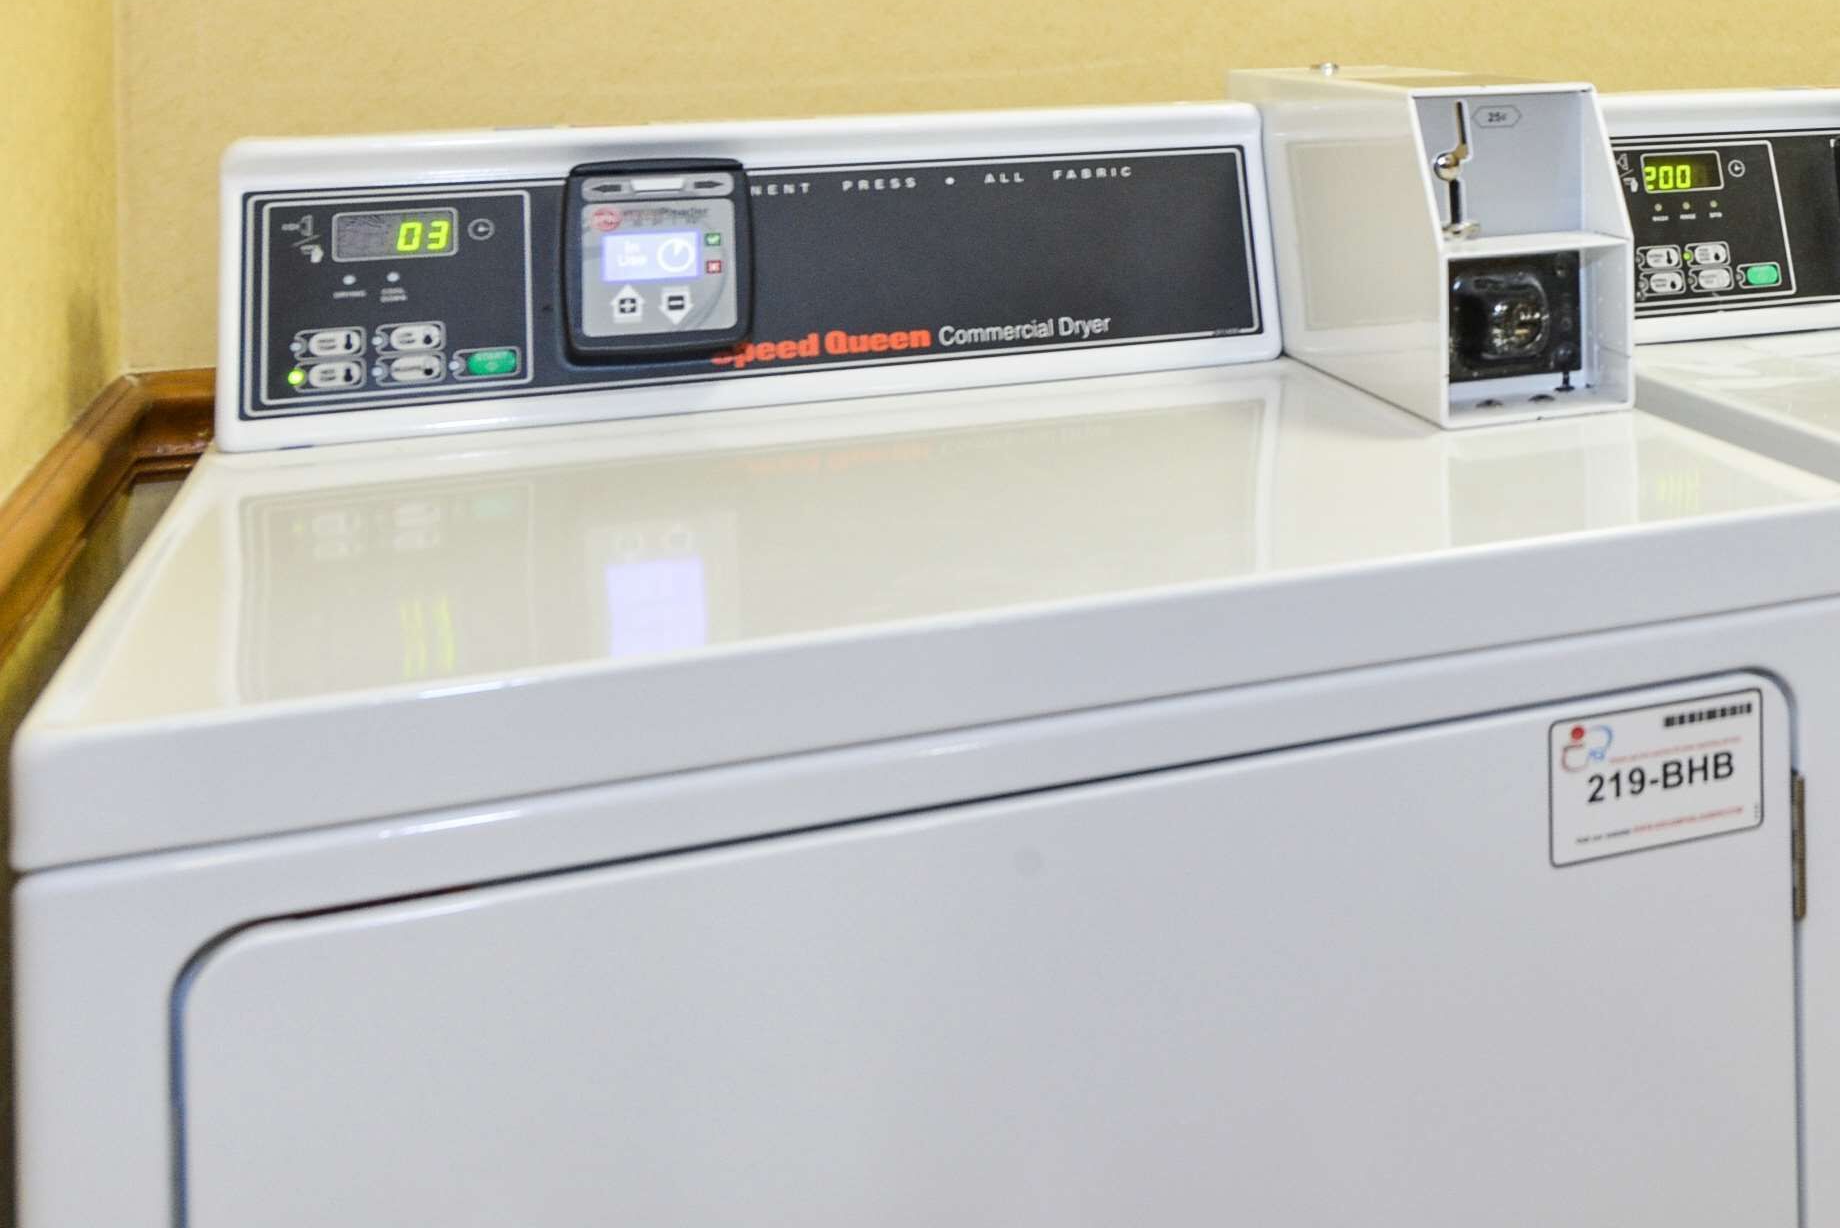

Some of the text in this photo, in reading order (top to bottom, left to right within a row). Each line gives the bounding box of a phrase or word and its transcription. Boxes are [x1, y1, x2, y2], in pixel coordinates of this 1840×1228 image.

[841, 176, 917, 192] PRESS
[984, 171, 1025, 184] ALL
[1052, 165, 1132, 181] FABRIC
[396, 220, 450, 252] 03
[710, 315, 1111, 369] peed Queen Commercial Dryer
[1587, 751, 1734, 804] 219-BHB
